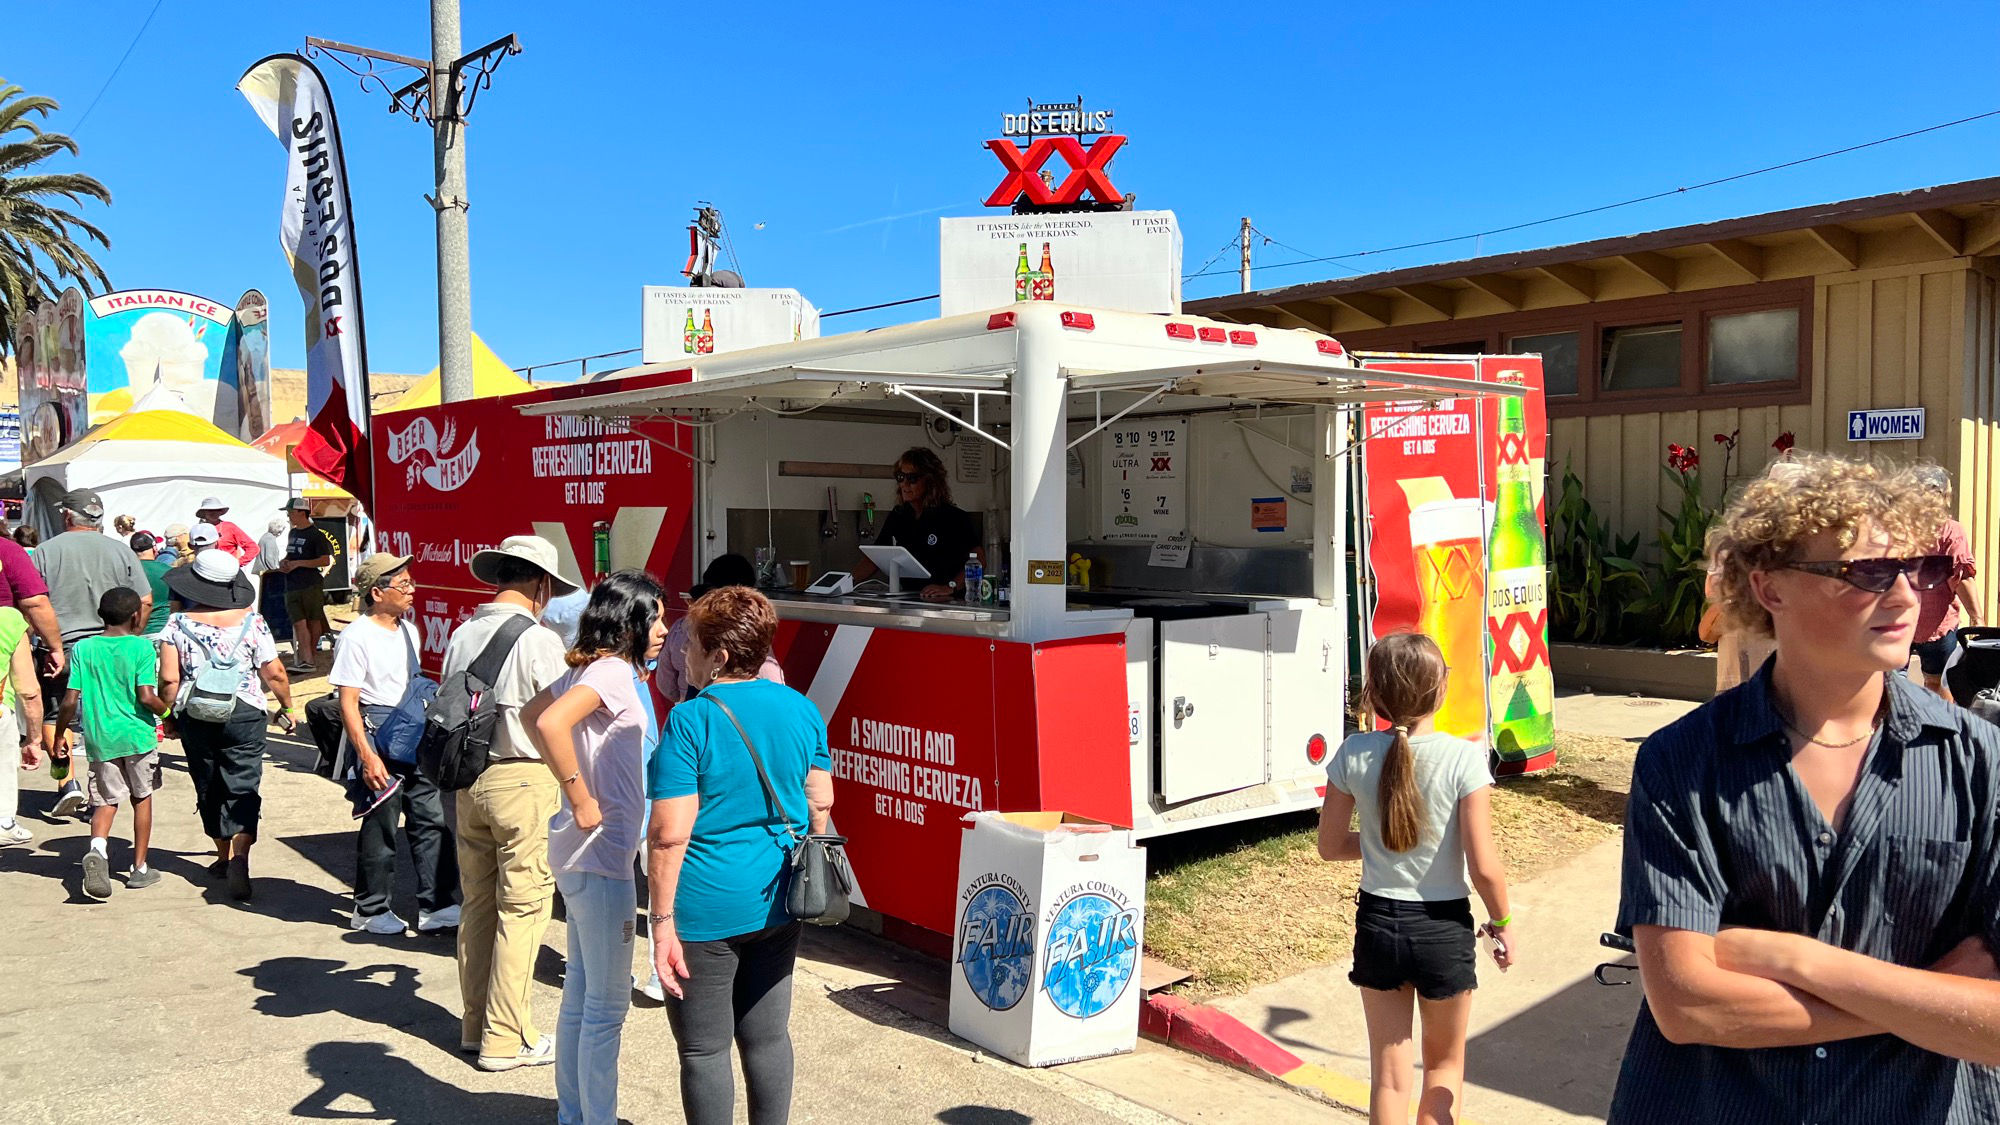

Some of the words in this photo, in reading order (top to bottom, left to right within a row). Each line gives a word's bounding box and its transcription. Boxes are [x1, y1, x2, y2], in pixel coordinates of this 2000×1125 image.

[1004, 113, 1042, 134] DOS
[1048, 111, 1106, 133] EQUIS
[292, 110, 336, 227] EQUIS
[983, 135, 1128, 207] XX
[987, 223, 1019, 231] TASTES
[991, 231, 1015, 239] EVEN
[1026, 230, 1079, 238] WEEKDAYS.
[319, 233, 342, 312] DOS
[107, 294, 183, 309] ITALIAN
[188, 298, 217, 316] ICE
[545, 416, 552, 439] A
[1114, 433, 1123, 444] $8
[1126, 432, 1140, 443] $10
[1148, 431, 1157, 442] $9
[1161, 430, 1176, 442] $12
[1371, 415, 1427, 438] REFRESHING
[1428, 413, 1470, 436] CERVEZA
[1868, 414, 1920, 434] WOMEN
[397, 420, 425, 460] BEER
[1403, 440, 1415, 455] GET
[1416, 440, 1422, 454] A
[1497, 432, 1529, 466] XX
[441, 443, 473, 488] MENU
[532, 443, 593, 477] REFRESHING
[596, 440, 652, 475] CERVEZA
[1112, 459, 1140, 468] ULTRA
[1150, 457, 1171, 471] XX
[565, 483, 578, 504] GET
[580, 482, 585, 504] A
[1121, 488, 1131, 500] $6
[1157, 496, 1166, 507] $7
[1492, 588, 1510, 607] DOS
[1513, 583, 1543, 605] EQUIS
[423, 615, 452, 654] XX
[1488, 608, 1551, 676] XX
[851, 717, 859, 746] A
[862, 719, 920, 759] SMOOTH
[924, 730, 955, 766] AND
[830, 748, 909, 794] REFRESHING
[913, 766, 982, 811] CERVEZA
[875, 793, 892, 817] GET
[895, 798, 902, 819] A
[962, 872, 999, 901] VENTURA
[1001, 873, 1032, 909] COUNTY
[1045, 883, 1084, 924] VENTURA
[1087, 880, 1131, 906] COUNTY
[956, 912, 1037, 964] FAIR
[1040, 907, 1140, 993] FAIR
